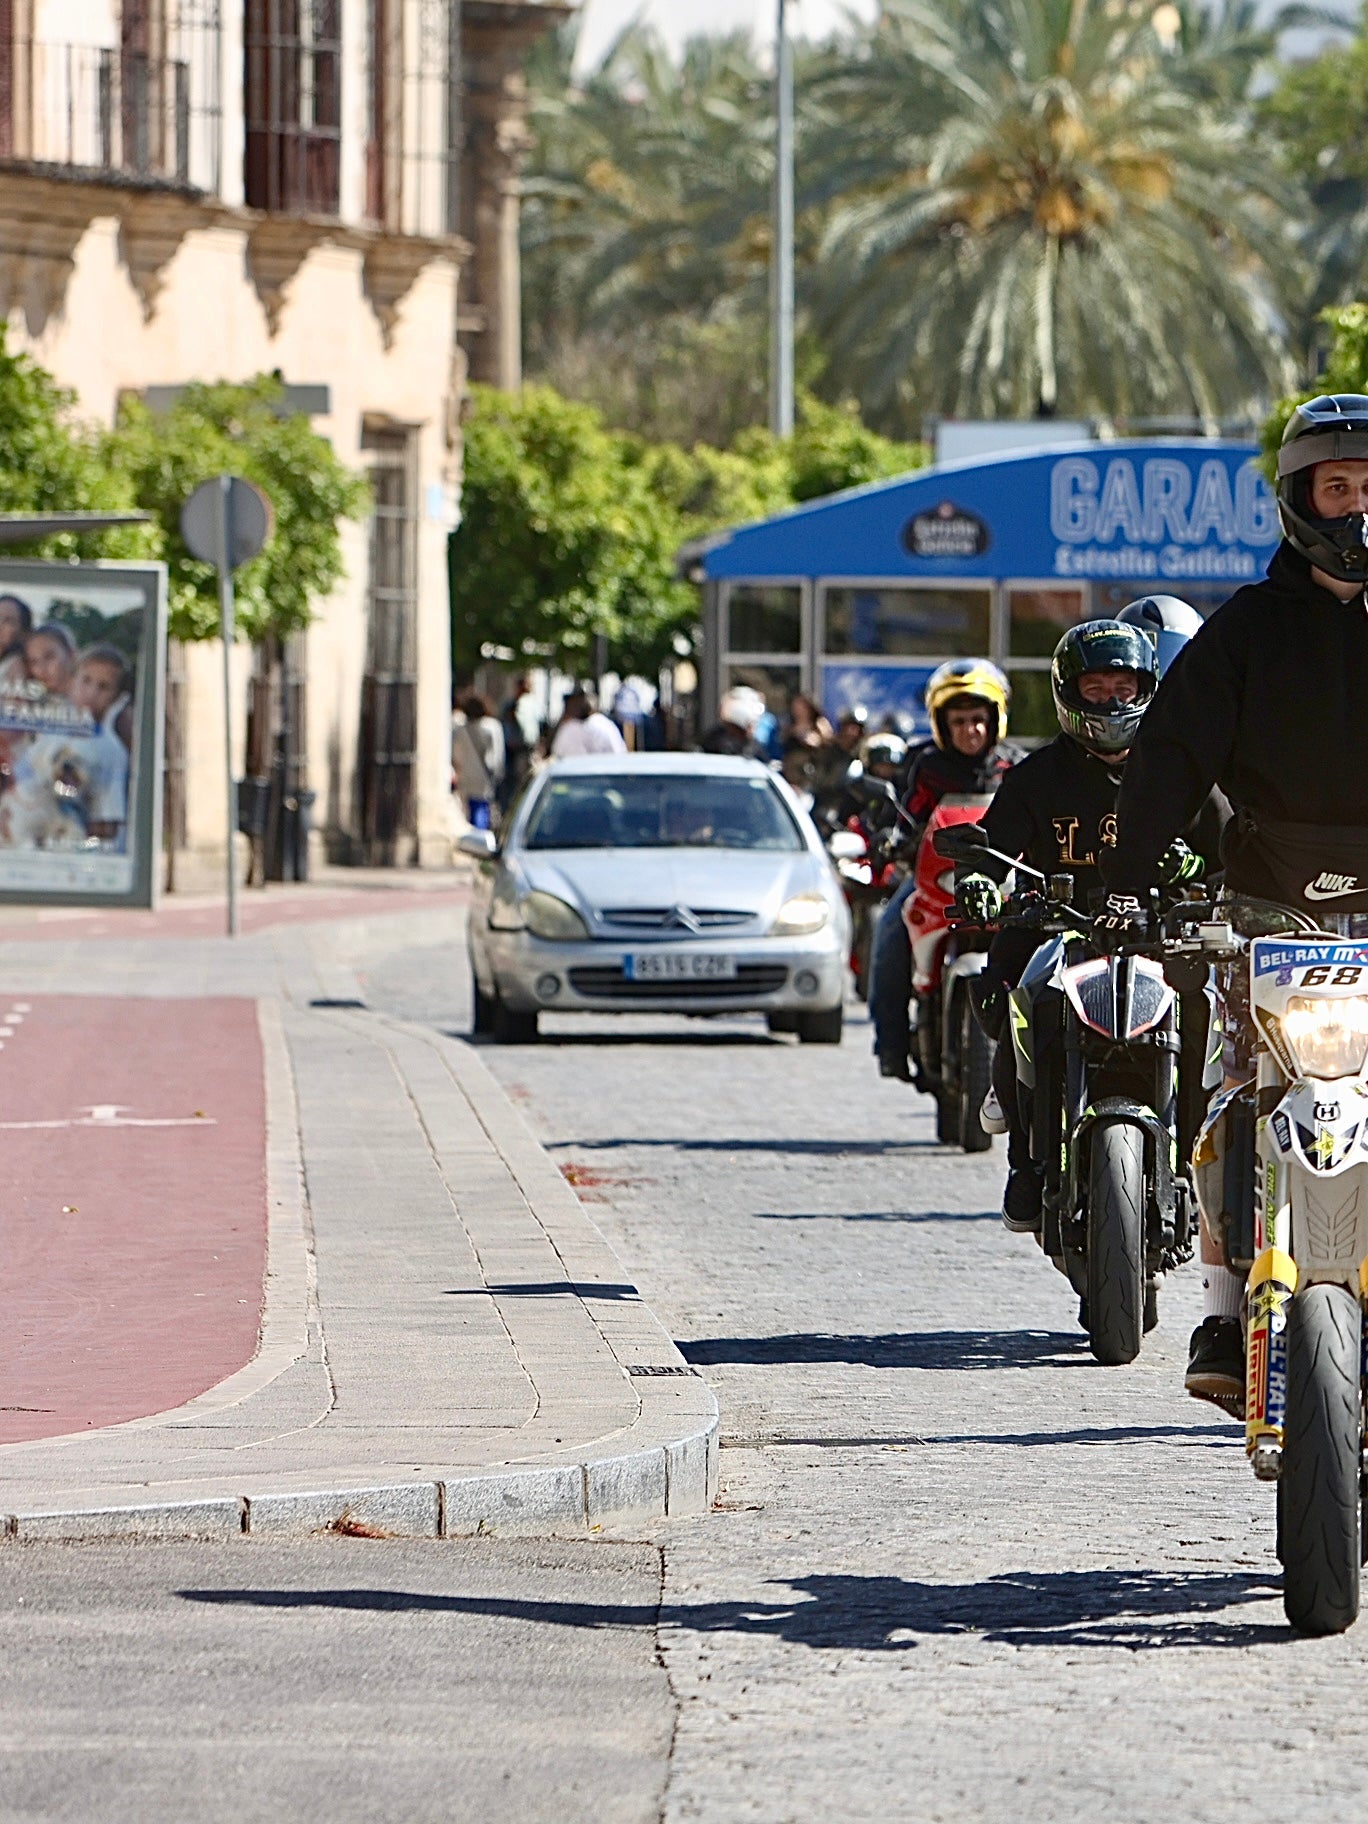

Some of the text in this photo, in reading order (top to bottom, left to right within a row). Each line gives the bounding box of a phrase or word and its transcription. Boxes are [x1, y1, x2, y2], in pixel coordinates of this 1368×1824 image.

[1314, 872, 1358, 892] NIKE
[1093, 915, 1133, 931] FOX
[1300, 966, 1363, 987] 68
